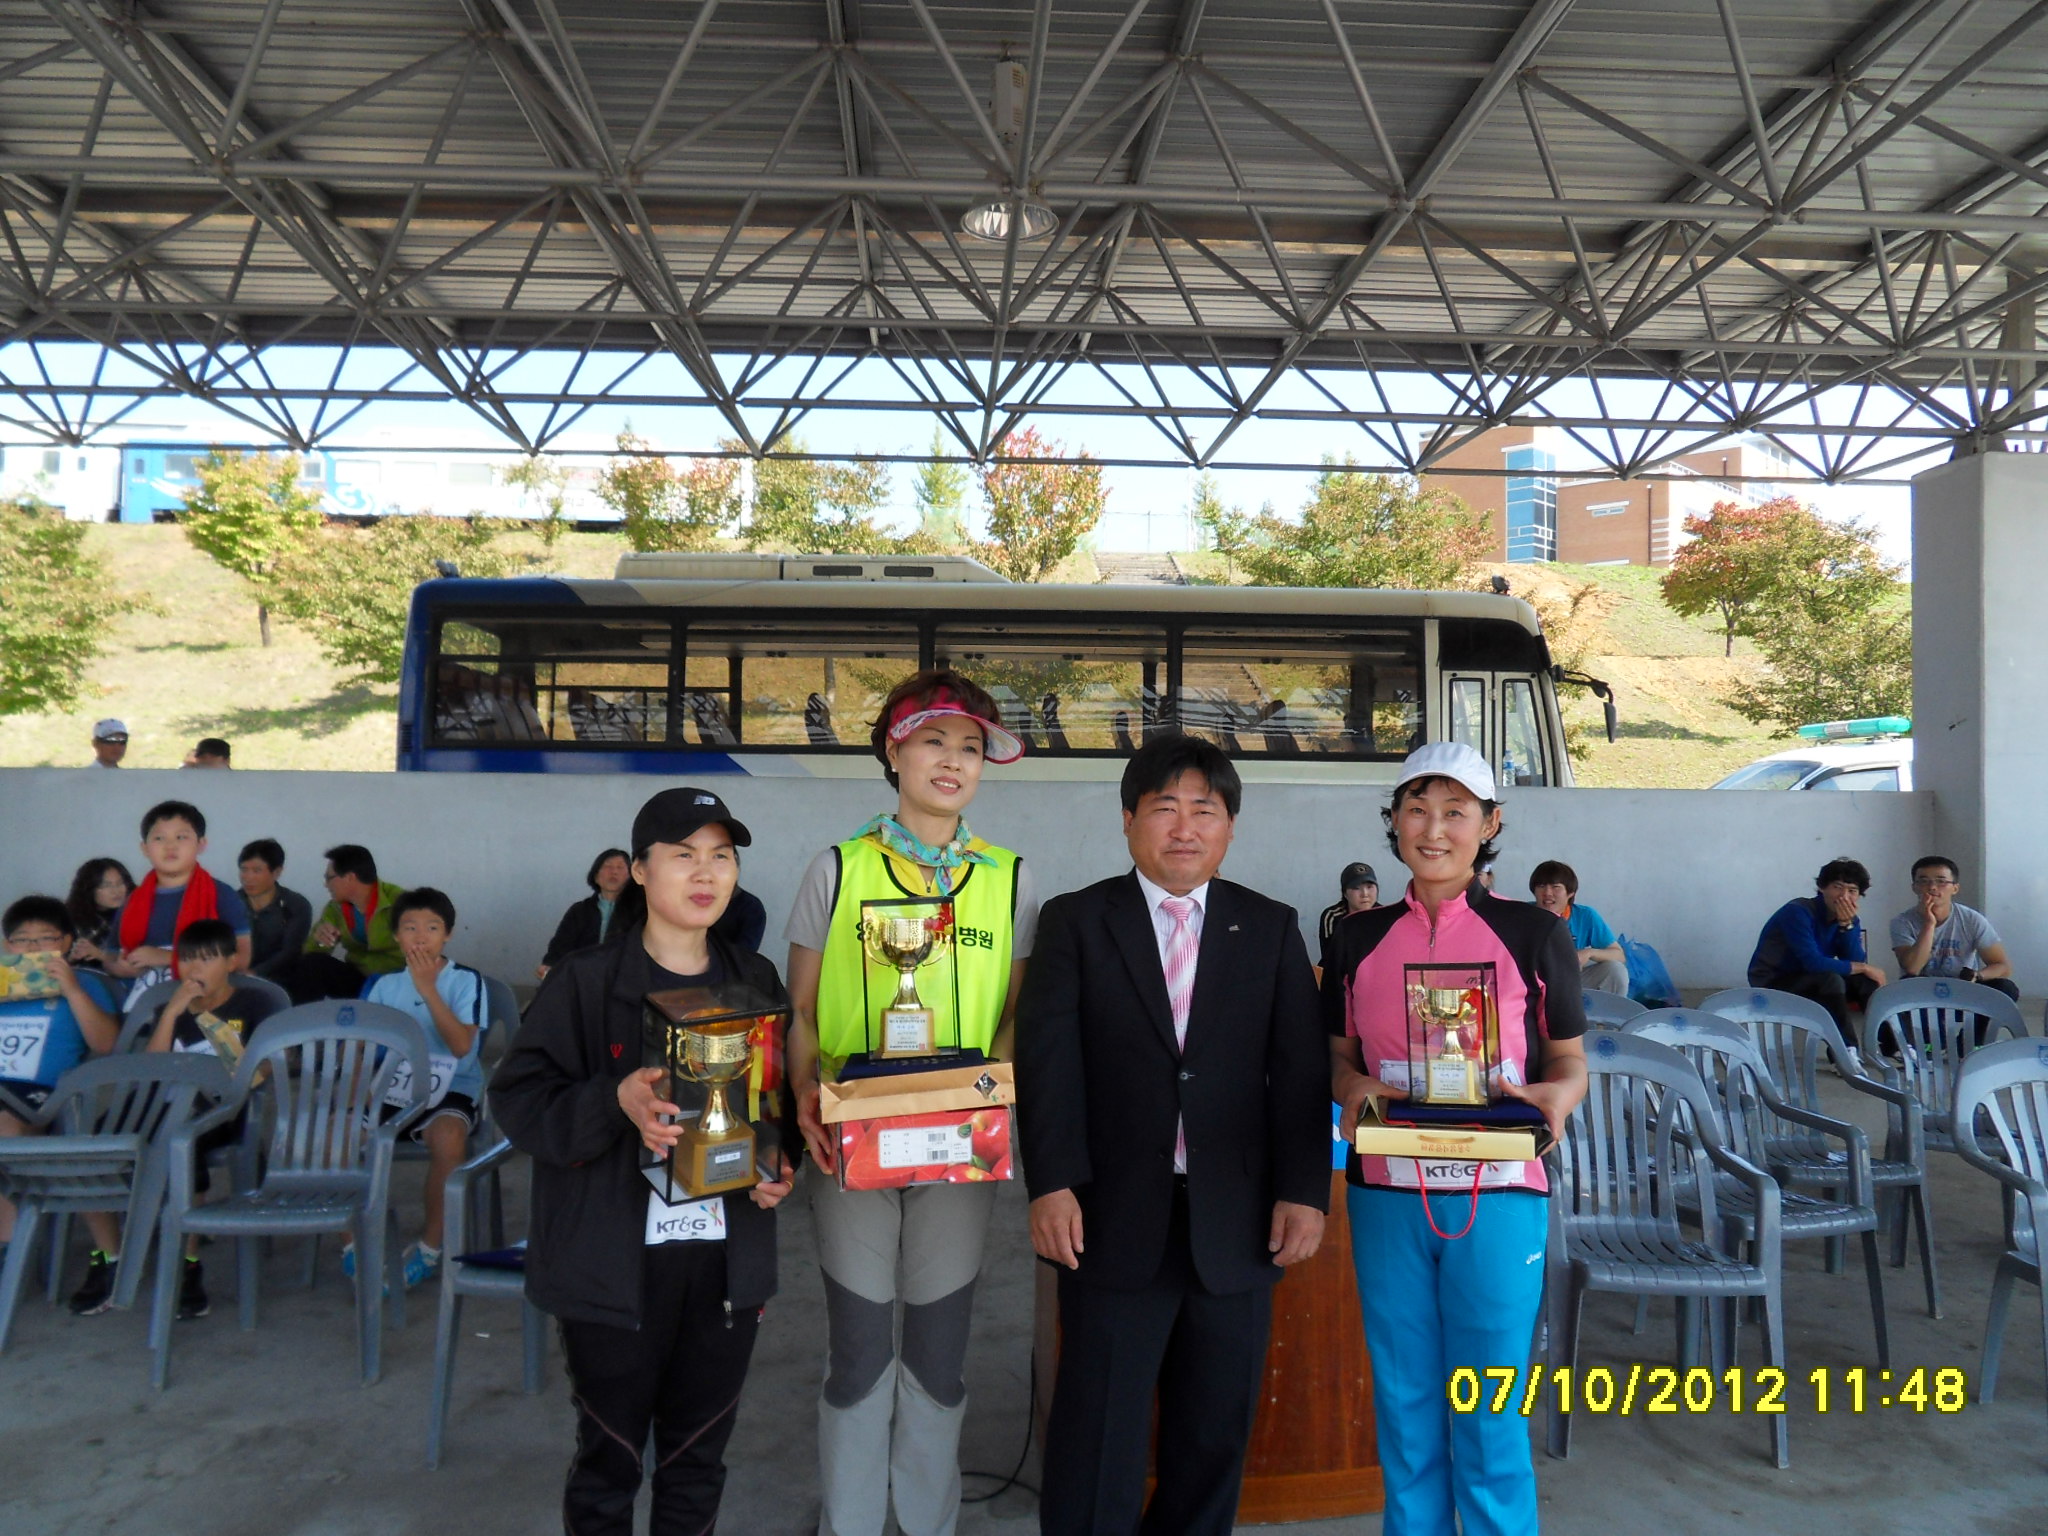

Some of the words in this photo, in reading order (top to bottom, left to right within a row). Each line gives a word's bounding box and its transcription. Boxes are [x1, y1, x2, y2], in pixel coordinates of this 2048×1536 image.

[0, 1035, 40, 1057] 97
[1425, 1162, 1478, 1179] KT&G
[656, 1215, 708, 1234] KT&G
